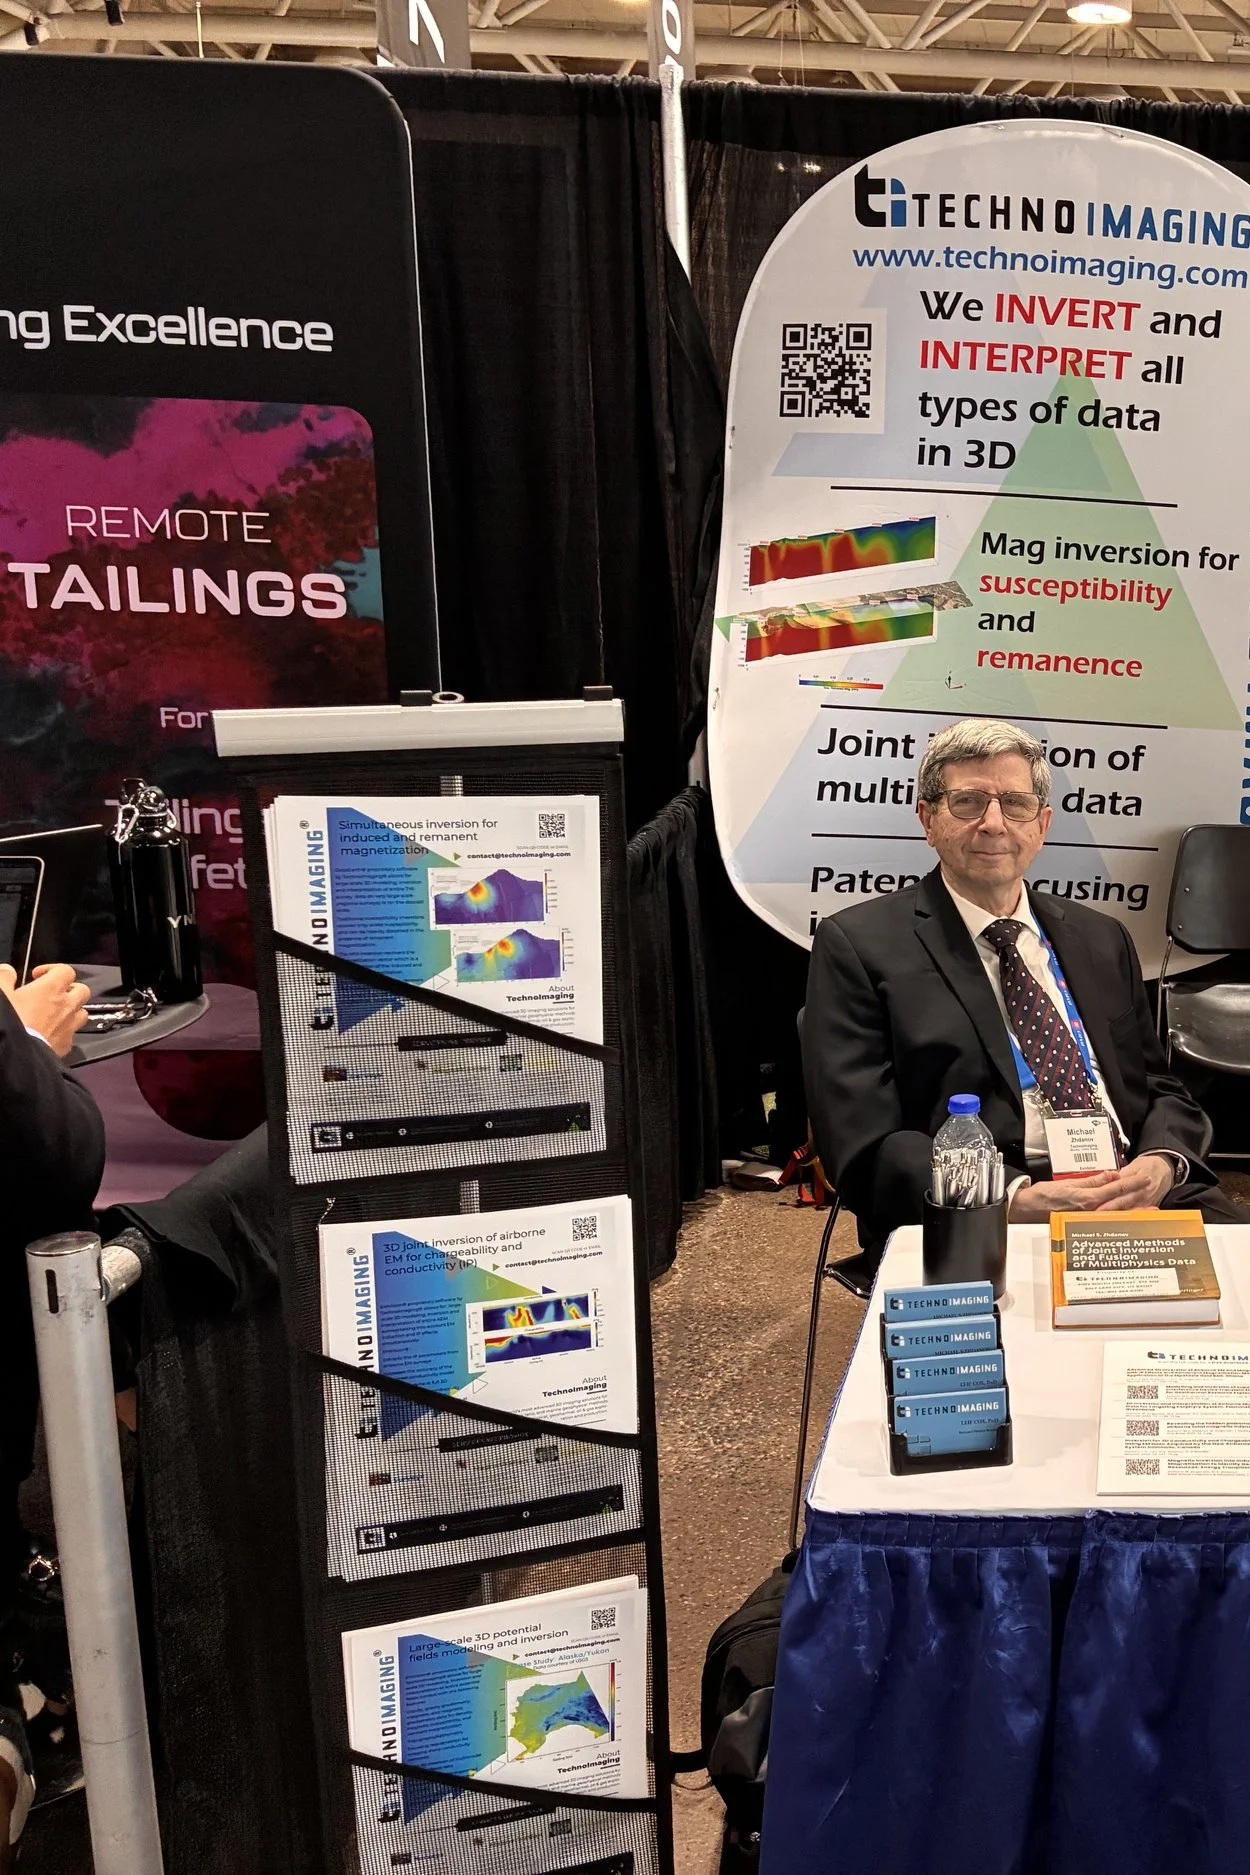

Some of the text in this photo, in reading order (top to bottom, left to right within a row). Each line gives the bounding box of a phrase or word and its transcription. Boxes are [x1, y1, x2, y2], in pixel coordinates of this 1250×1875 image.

[853, 245, 1248, 288] www.technoimaging.com
[920, 290, 1223, 338] We INVERT and
[63, 305, 334, 352] Excellence
[919, 340, 1184, 384] INTERPRET all
[919, 390, 1161, 431] types of data
[917, 437, 1016, 470] in 3D
[66, 504, 272, 544] REMOTE
[981, 532, 1240, 571] Mag inversion for
[7, 562, 347, 619] TAILINGS
[979, 574, 1173, 611] susceptibility
[977, 611, 1035, 633] and
[977, 649, 1143, 677] remanence
[160, 707, 210, 729] For
[817, 727, 915, 760] Joint
[1108, 745, 1146, 772] of
[1061, 787, 1143, 817] data
[338, 818, 498, 831] Simultaneous inversion for
[339, 832, 478, 843] induced and remanent
[340, 845, 429, 858] magnetization
[467, 851, 571, 860] contact@technoimaging.com
[506, 992, 574, 1002] TechnoImaging
[1067, 1128, 1095, 1136] Michael
[383, 1228, 546, 1253] 3D joint inversion of airborne
[1134, 1239, 1186, 1247] Methods
[384, 1241, 522, 1265] EM for chargeability and
[505, 1251, 603, 1268] contact@technoimaging.com
[1072, 1246, 1175, 1255] of Joint Inversion
[384, 1262, 456, 1277] conductivity
[1089, 1260, 1165, 1268] Multiphysics
[908, 1296, 989, 1309] TECHNOIMAGING
[909, 1331, 991, 1345] TECHNOIMAGING
[582, 1375, 607, 1384] About
[914, 1363, 998, 1378] TECHNOIMAGING
[542, 1382, 607, 1397] TechnoImaging
[914, 1401, 999, 1416] TECHNOIMAGING
[409, 1623, 542, 1653] Large-scale 3D potential
[409, 1651, 439, 1662] fields
[441, 1642, 494, 1656] modeling
[497, 1638, 518, 1648] and
[520, 1629, 569, 1645] inversion
[524, 1638, 620, 1658] contact@technoimaging.com
[558, 1648, 610, 1661] Alaska/Yukon
[597, 1750, 620, 1760] About
[557, 1757, 620, 1773] TechnoImaging
